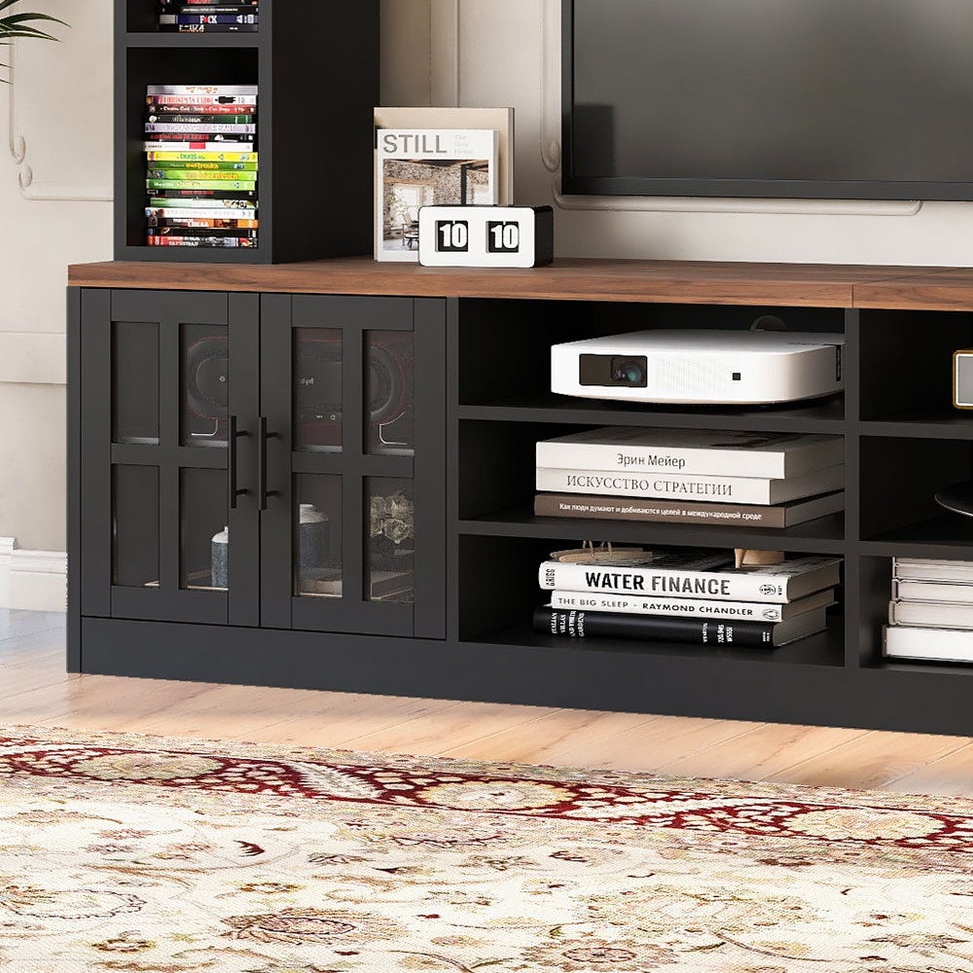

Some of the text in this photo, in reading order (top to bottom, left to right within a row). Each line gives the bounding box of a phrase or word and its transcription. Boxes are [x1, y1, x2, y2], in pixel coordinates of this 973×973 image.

[383, 134, 447, 154] STILL
[440, 223, 519, 249] 10 10
[616, 453, 686, 469] Эрин Мейер
[566, 475, 733, 497] ИСКУССТВО СТРАТЕГИИ
[559, 503, 571, 511] Как
[572, 504, 589, 513] люди
[590, 505, 614, 514] думают
[621, 506, 660, 516] добиваются
[661, 507, 681, 517] целей
[687, 510, 741, 520] международной
[742, 512, 762, 521] среде
[585, 571, 731, 596] WATER FINANCE
[558, 597, 754, 617] THE BIG SLEEP RAYMOND CHANDLER
